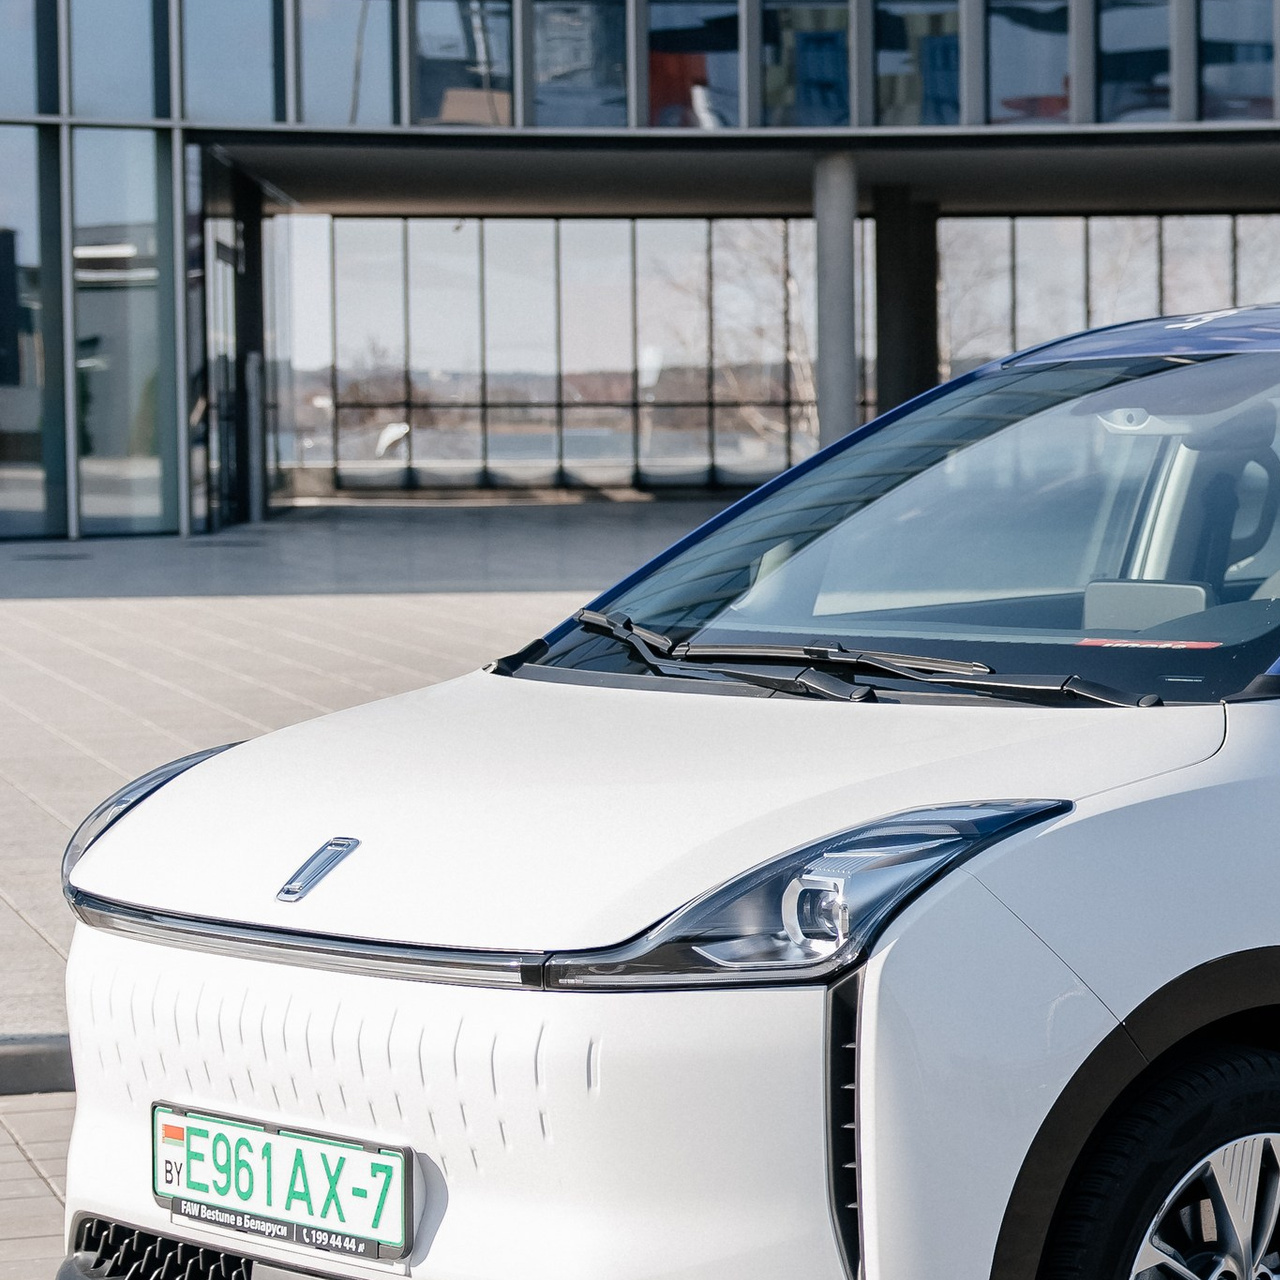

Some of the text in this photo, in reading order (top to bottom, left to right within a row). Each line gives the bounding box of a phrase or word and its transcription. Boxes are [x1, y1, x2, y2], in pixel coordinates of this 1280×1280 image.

[164, 1159, 184, 1187] BY
[181, 1200, 288, 1237] FAW Bestune в Беларуси
[310, 1230, 328, 1246] 199
[329, 1233, 342, 1249] 44
[343, 1236, 356, 1252] 44
